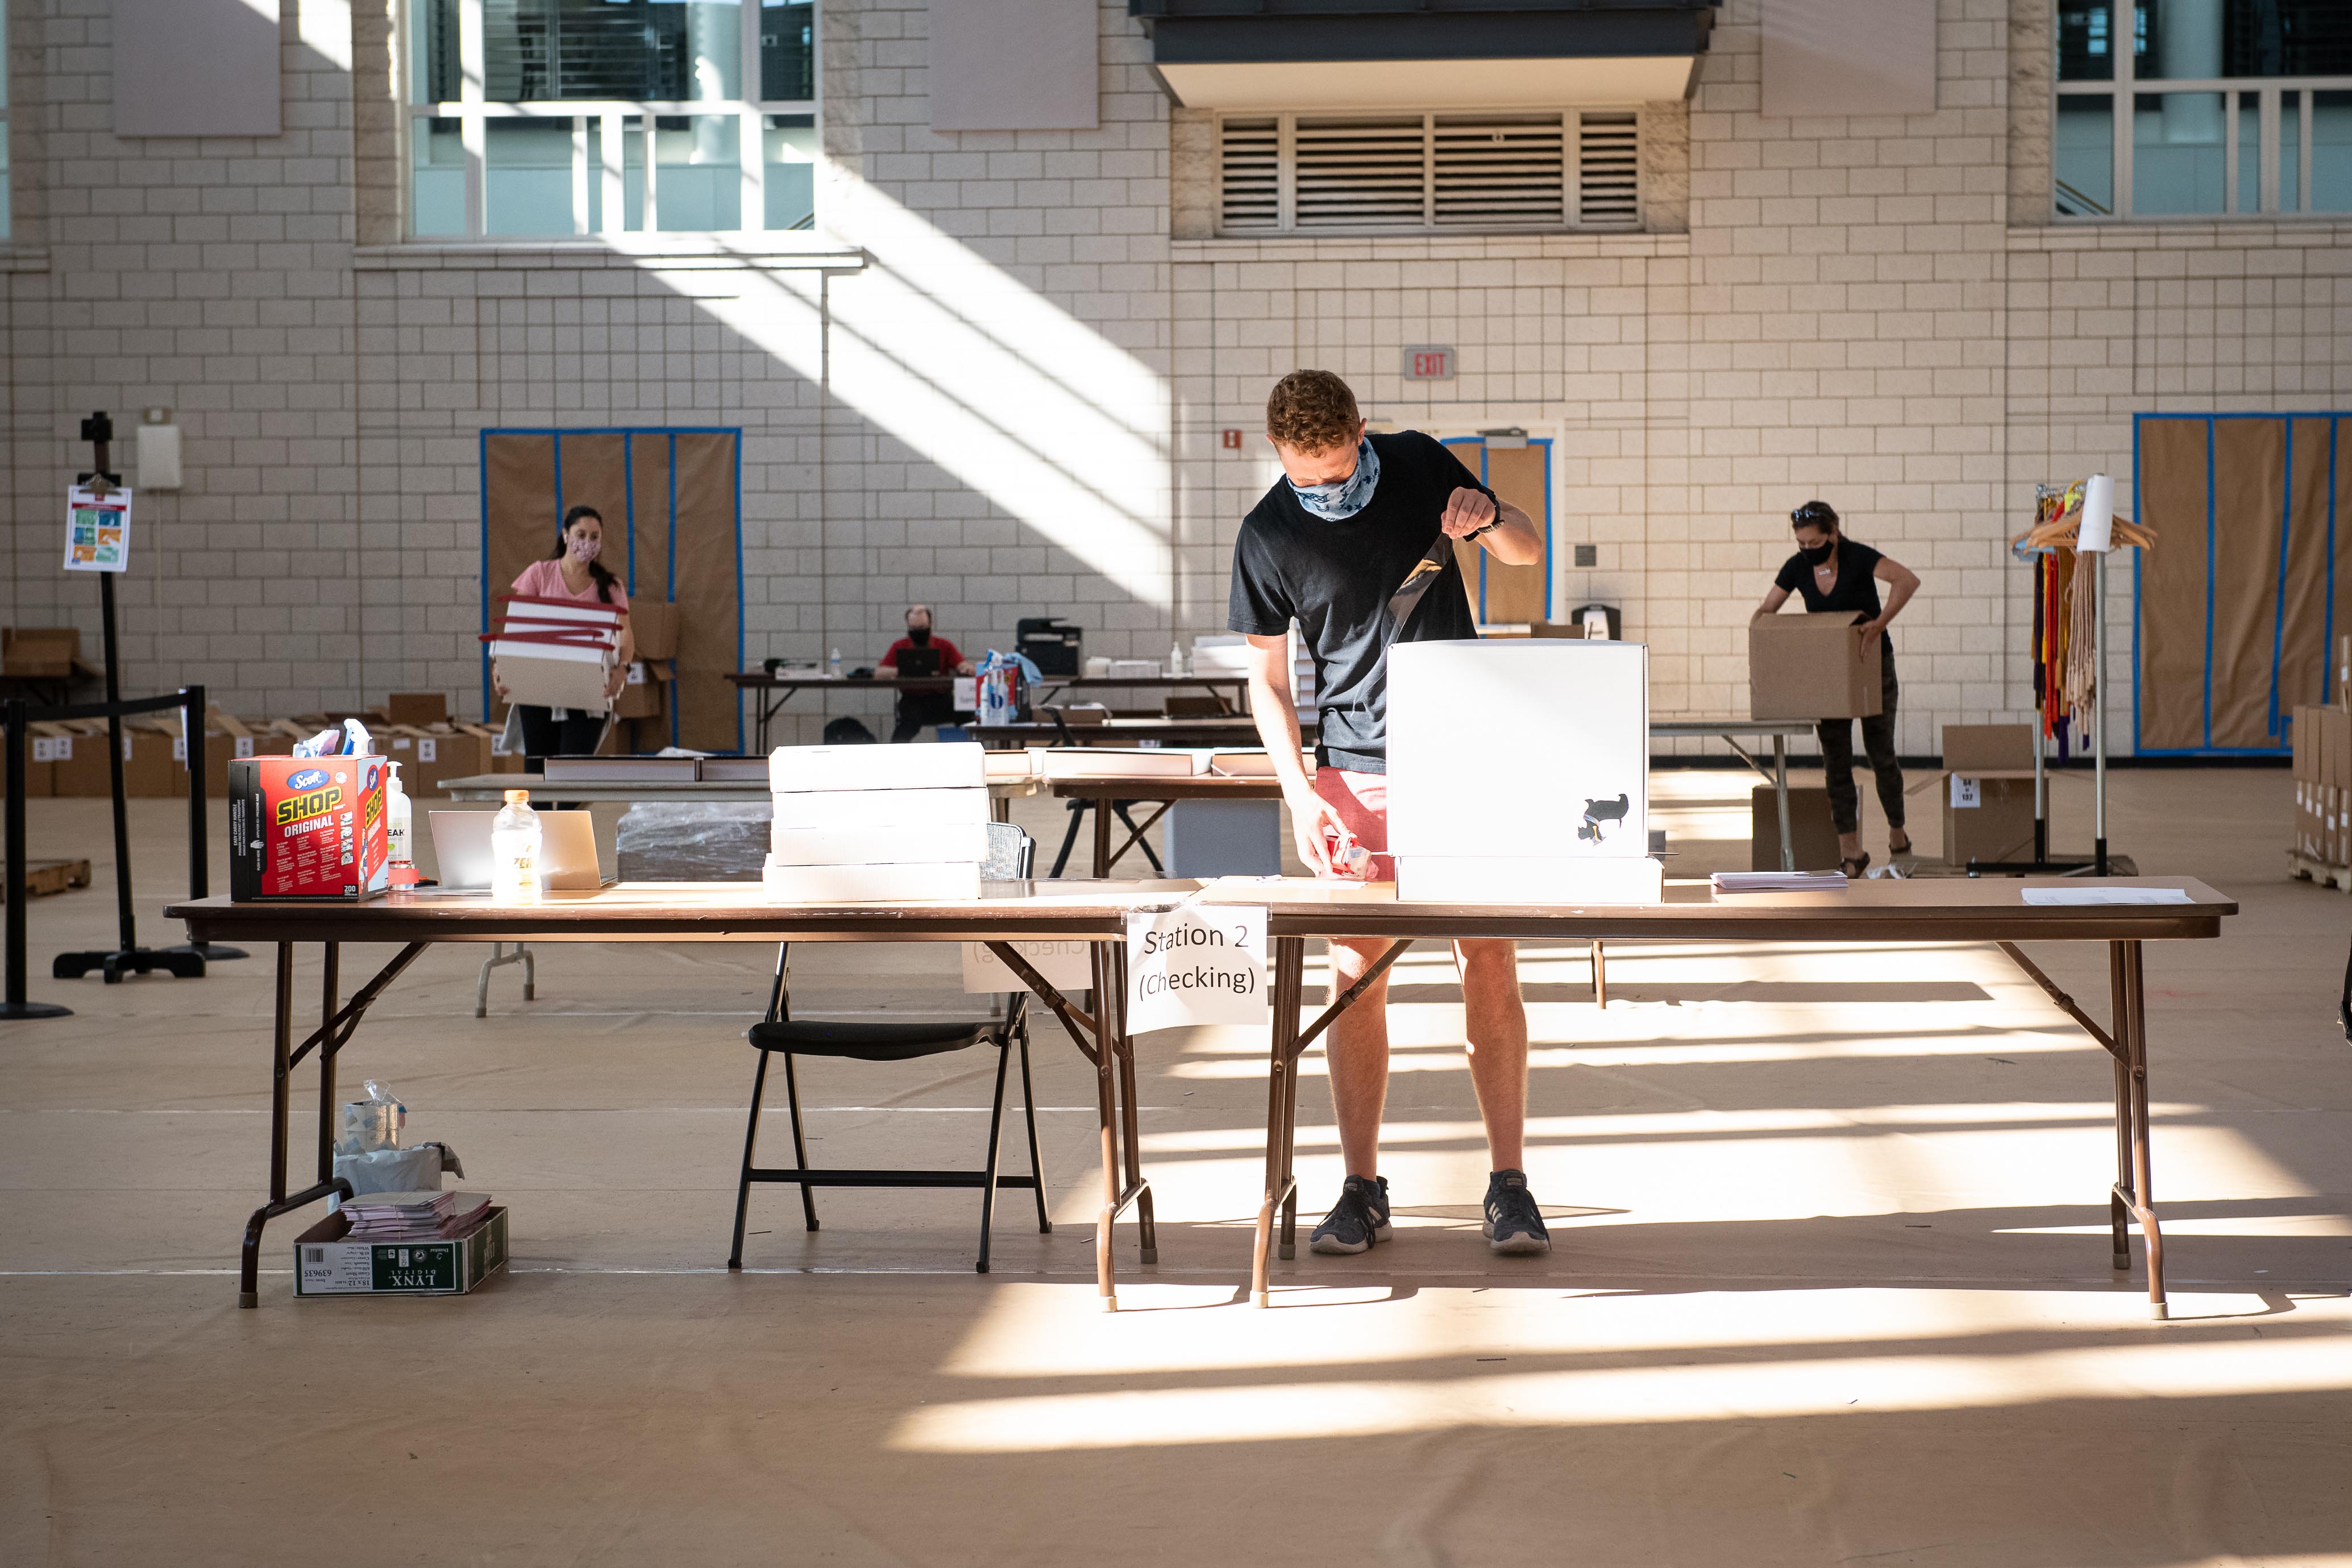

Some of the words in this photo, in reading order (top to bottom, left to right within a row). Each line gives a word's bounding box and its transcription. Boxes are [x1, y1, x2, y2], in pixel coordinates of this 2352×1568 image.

[1415, 353, 1445, 376] EXIT
[294, 771, 321, 789] Scott
[277, 787, 341, 825] SHOP
[365, 786, 382, 829] SHOP
[284, 815, 334, 838] ORIGINAL
[513, 858, 538, 868] ZER
[1144, 923, 1223, 954] Station
[1235, 925, 1249, 947] 2
[1140, 966, 1254, 1002] (Checking)
[392, 1275, 435, 1286] LYNX
